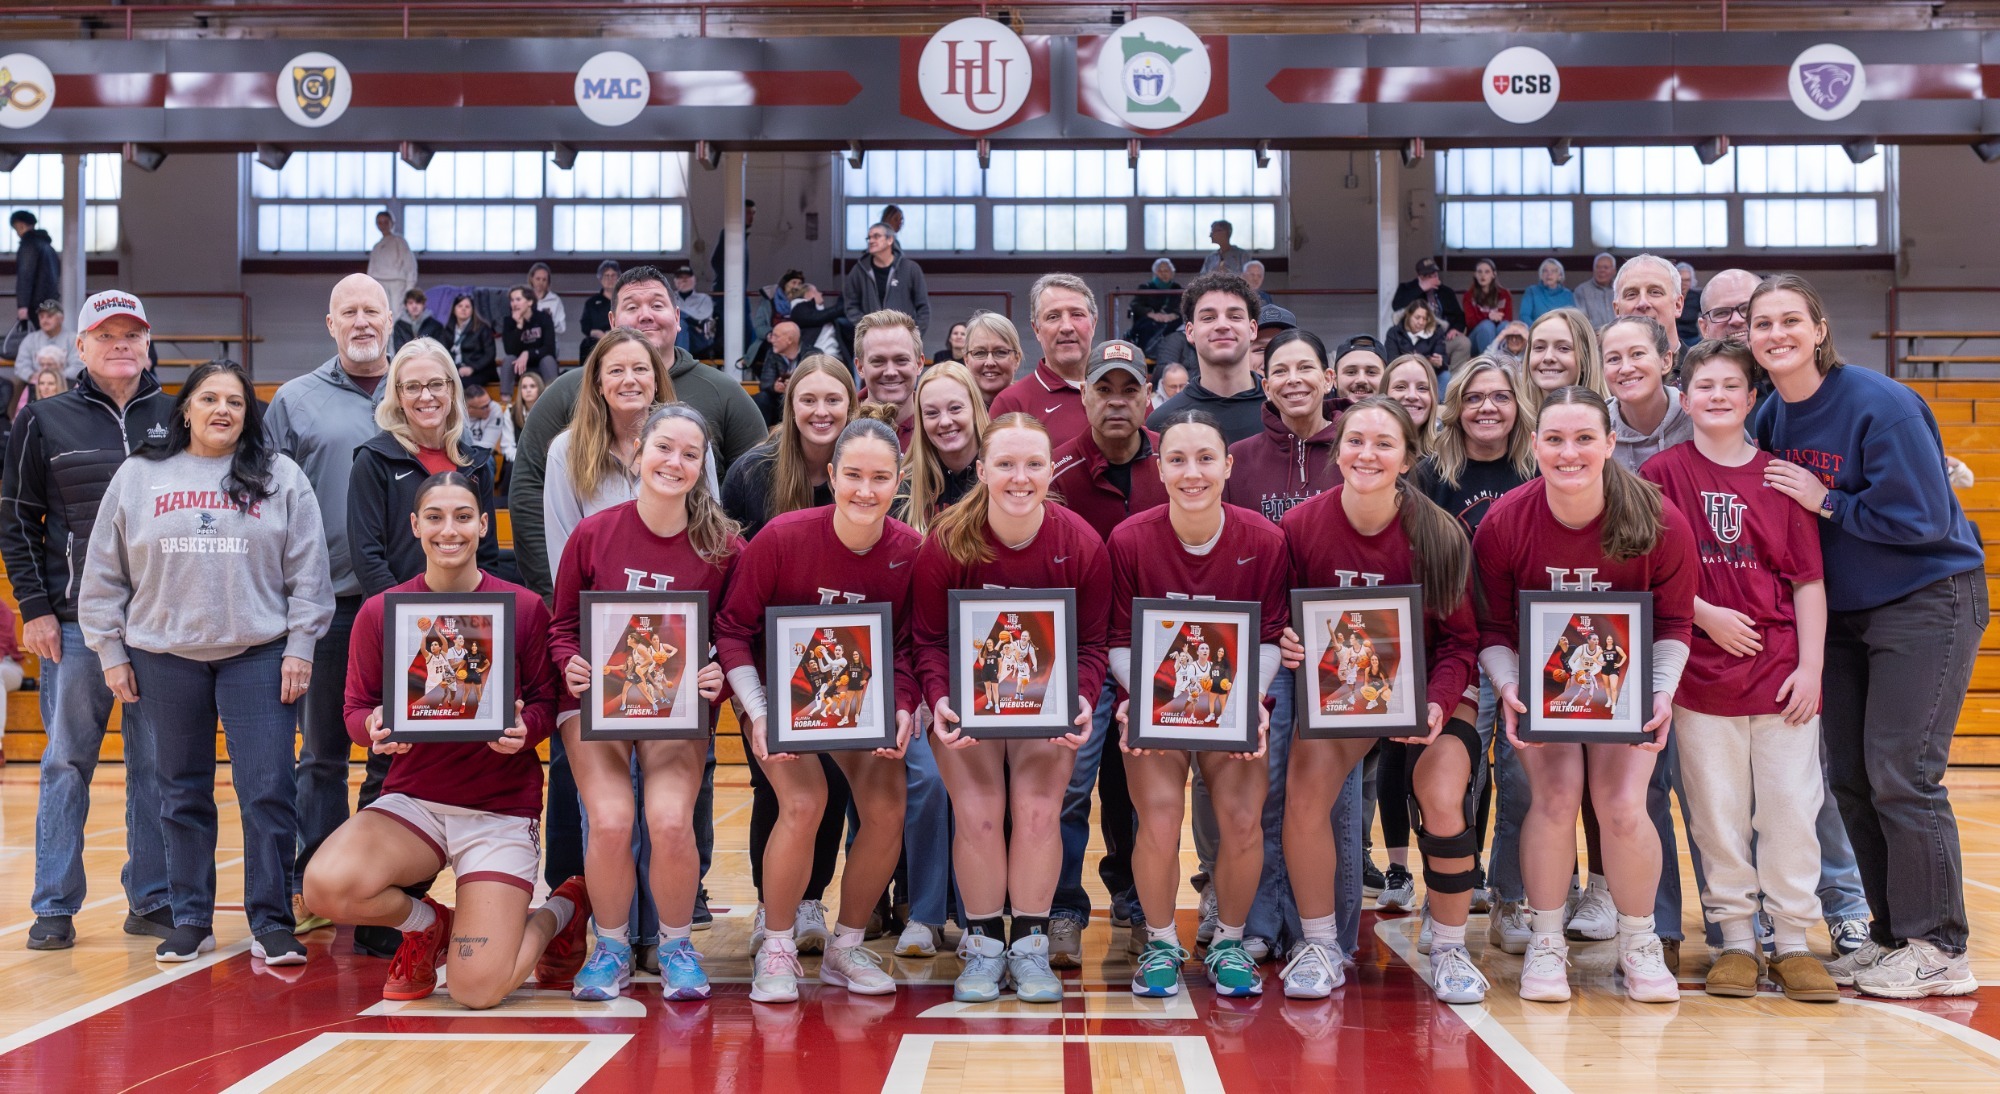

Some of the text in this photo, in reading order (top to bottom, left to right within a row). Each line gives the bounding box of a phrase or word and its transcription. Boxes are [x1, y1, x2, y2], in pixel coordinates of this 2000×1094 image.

[940, 40, 1013, 114] HU
[1511, 75, 1551, 94] CSB
[582, 78, 642, 99] MAC
[93, 297, 136, 309] HAMLINE
[1054, 455, 1073, 470] umbia
[1701, 491, 1748, 544] HU
[159, 537, 249, 554] BASKETBALL
[1701, 540, 1757, 563] HALINE
[625, 708, 650, 716] JENSEN
[1160, 716, 1197, 724] CUMMINGS
[794, 720, 821, 728] ROBRAN
[458, 943, 473, 960] Kills
